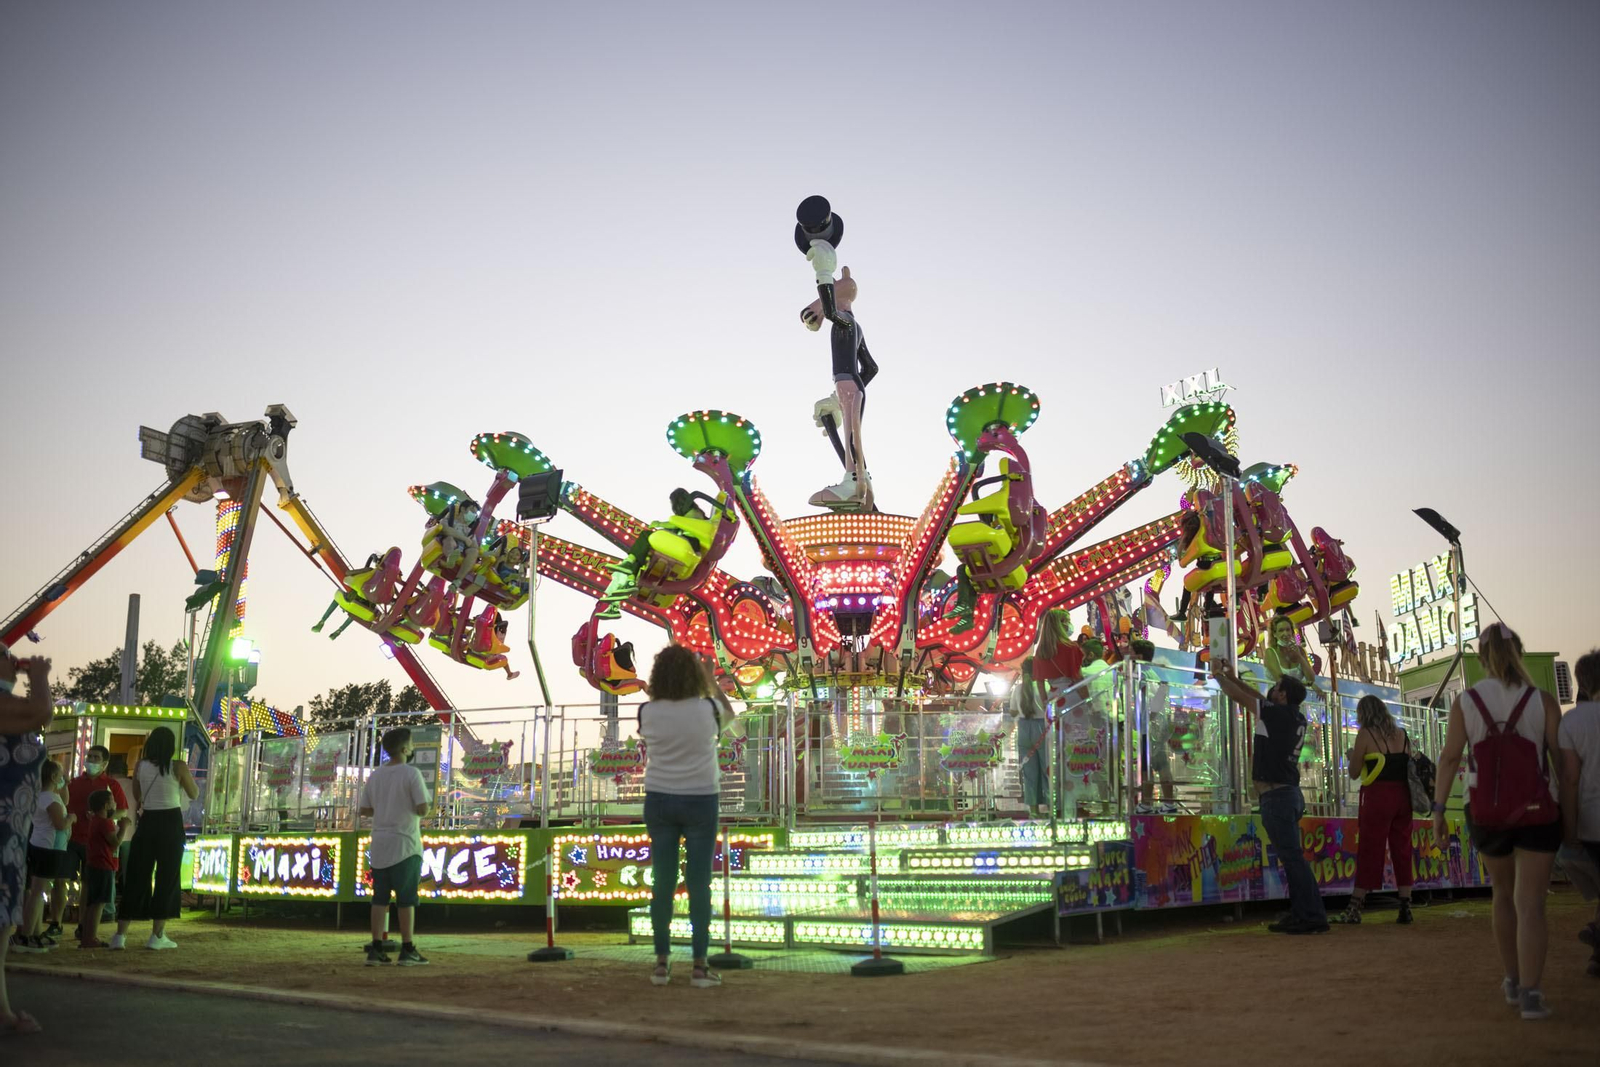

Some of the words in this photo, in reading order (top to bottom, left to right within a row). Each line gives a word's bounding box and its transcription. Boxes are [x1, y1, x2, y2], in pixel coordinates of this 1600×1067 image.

[1160, 367, 1229, 408] XXL
[1390, 549, 1463, 617] MAX
[801, 636, 808, 649] 9
[906, 628, 914, 641] 10
[1387, 592, 1479, 665] DANCE
[254, 847, 321, 882] MAXi
[421, 845, 497, 884] NCE
